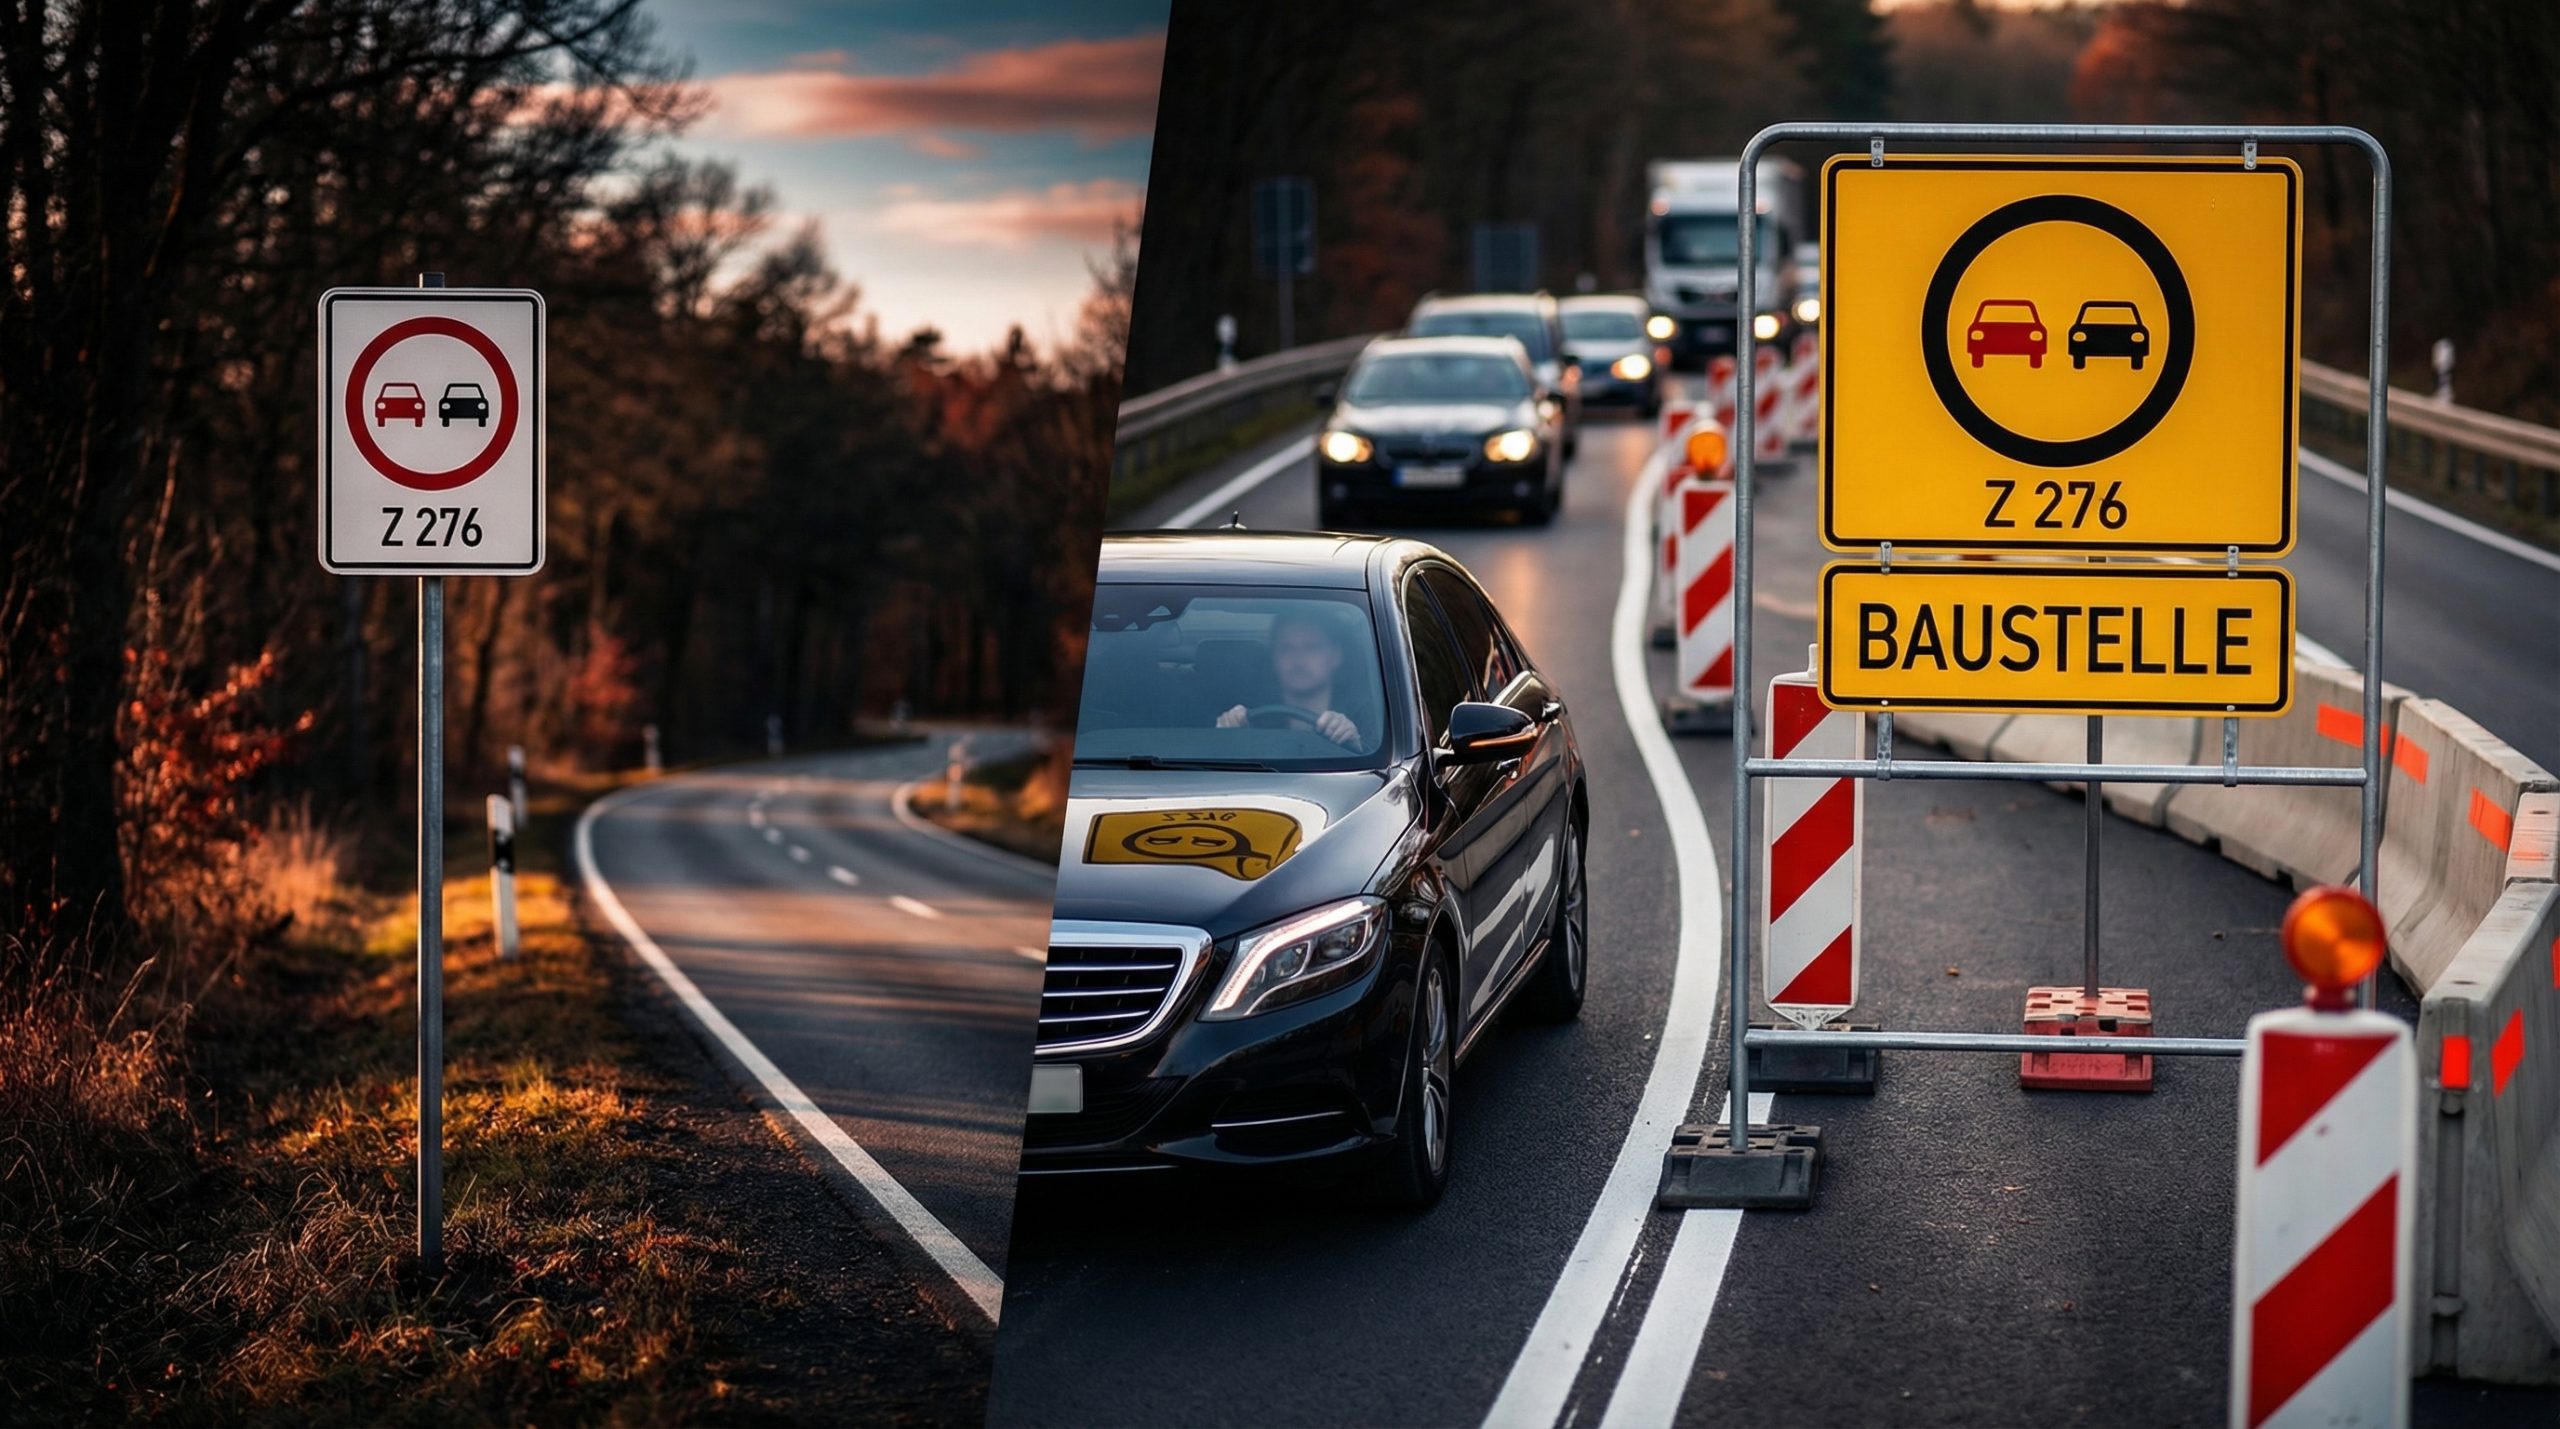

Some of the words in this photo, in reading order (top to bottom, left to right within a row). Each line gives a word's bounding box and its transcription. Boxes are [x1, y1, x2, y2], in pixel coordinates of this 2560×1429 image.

[381, 507, 404, 547] Z
[415, 507, 483, 548] 276
[1984, 479, 2016, 528] Z
[2034, 480, 2128, 530] 276
[1858, 602, 2253, 675] BAUSTELLE
